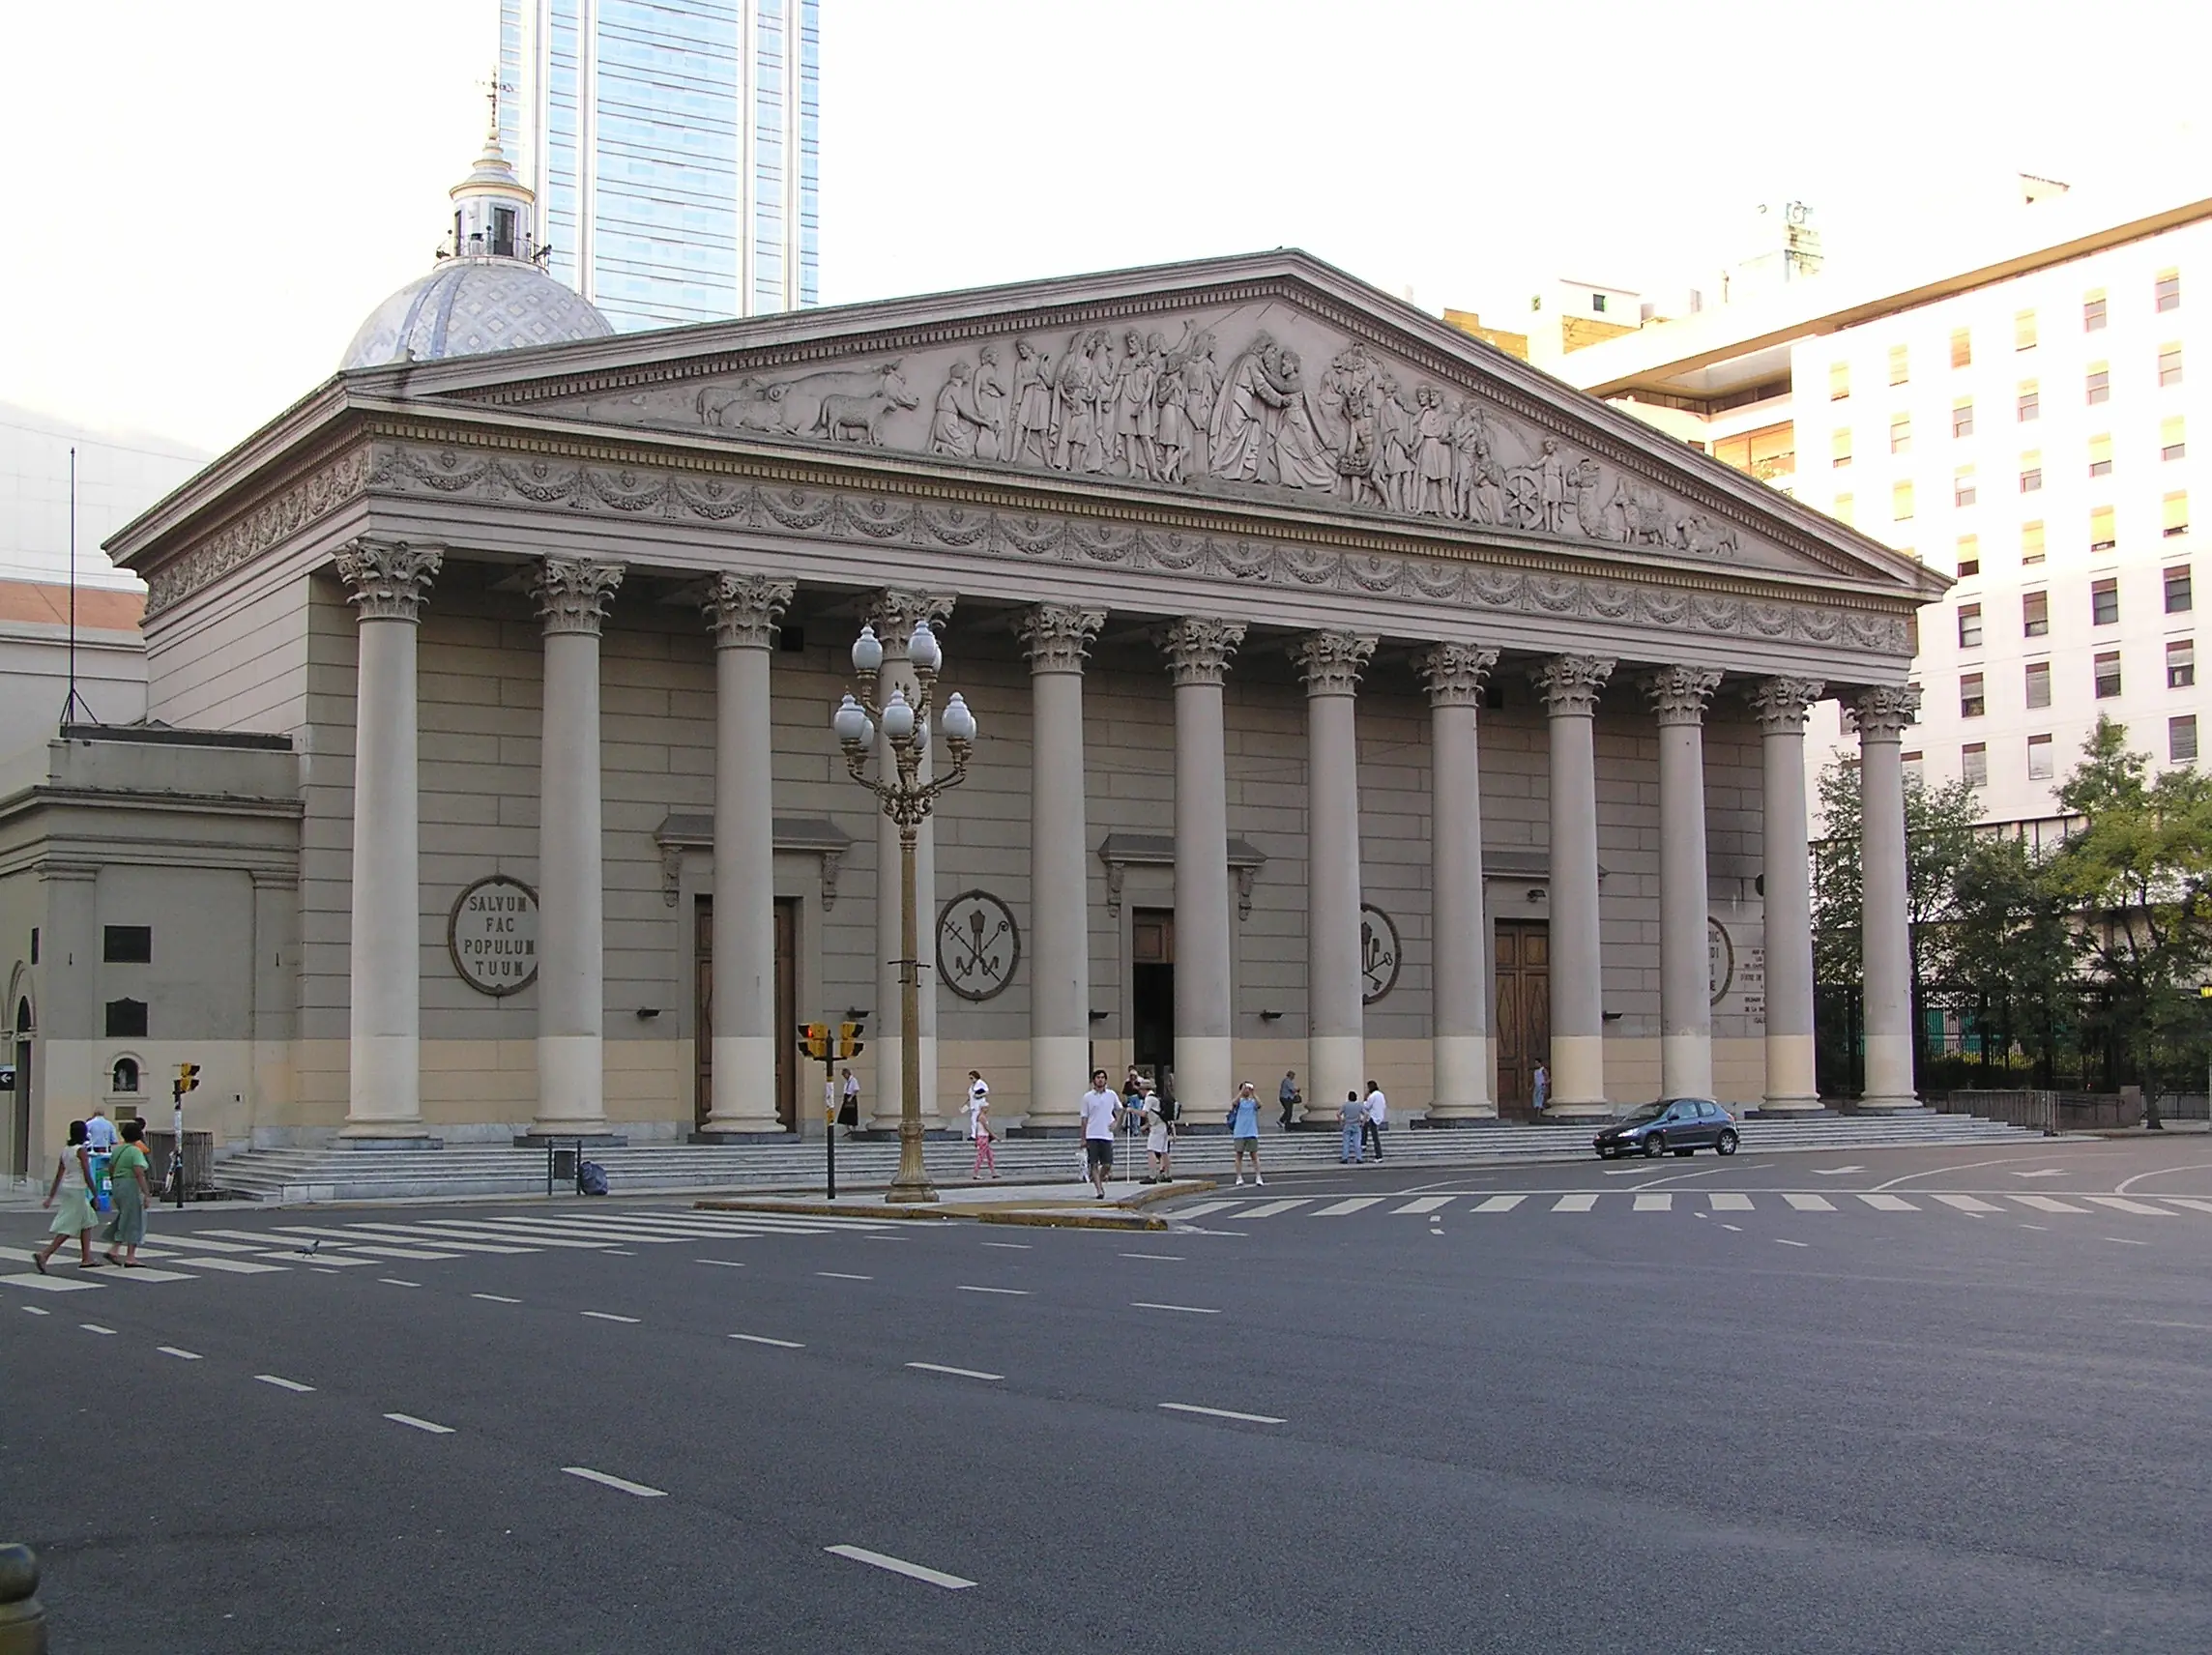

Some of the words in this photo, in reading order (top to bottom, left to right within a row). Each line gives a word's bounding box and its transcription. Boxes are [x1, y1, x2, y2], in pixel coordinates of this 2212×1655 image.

[469, 896, 527, 912] SALVUM
[486, 917, 514, 933] FAC
[464, 939, 535, 955] POPULUM
[475, 961, 524, 976] TUUM
